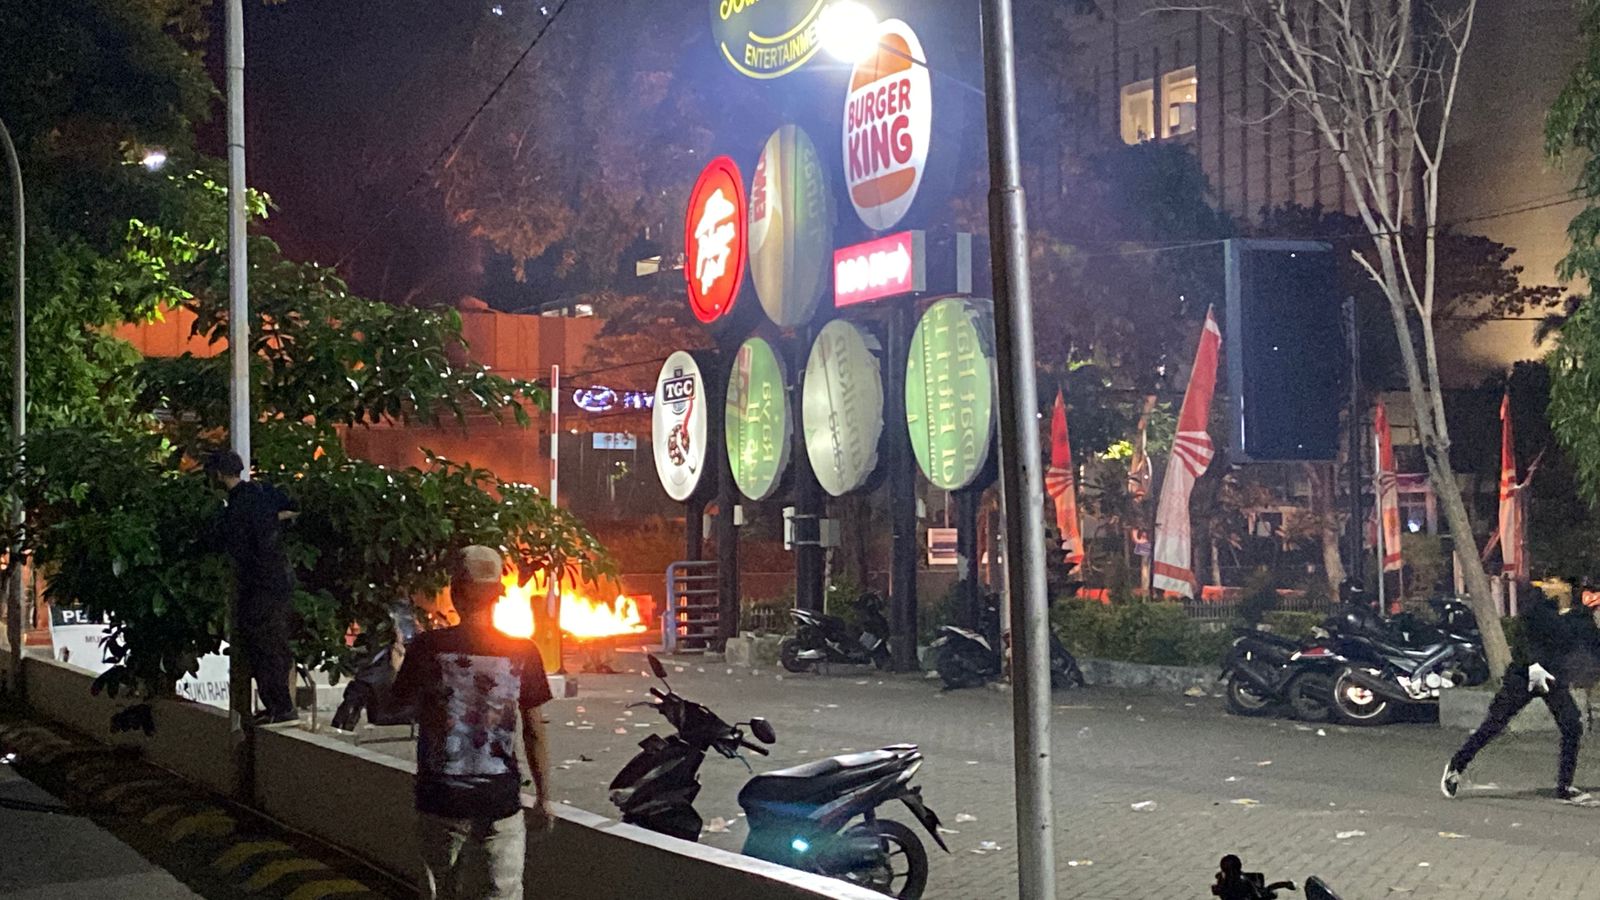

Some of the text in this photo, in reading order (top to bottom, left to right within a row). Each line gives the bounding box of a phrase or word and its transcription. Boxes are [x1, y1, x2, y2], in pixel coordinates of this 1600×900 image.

[744, 19, 819, 69] ENTERTAINME
[848, 79, 911, 133] BURGER
[848, 115, 913, 182] KING
[666, 380, 693, 398] TGC
[207, 681, 230, 701] RAH
